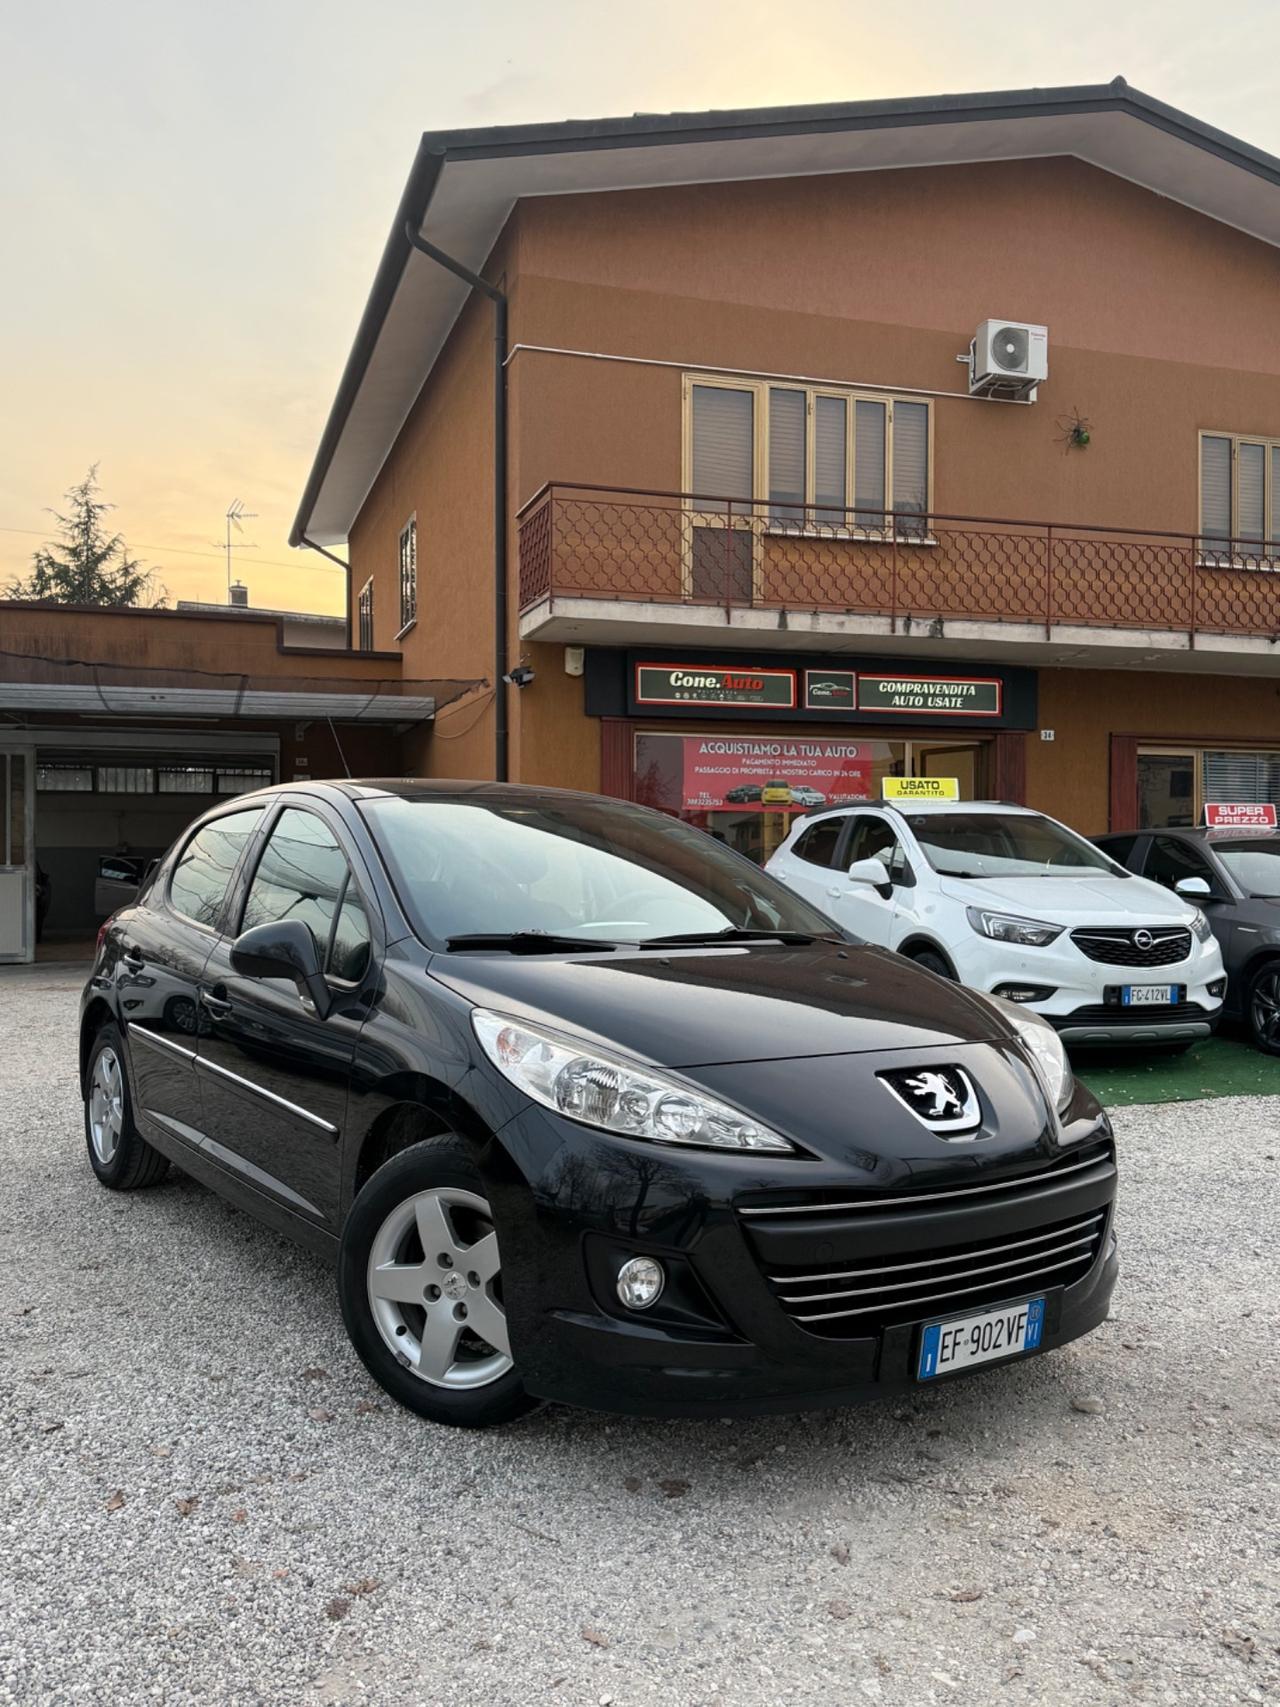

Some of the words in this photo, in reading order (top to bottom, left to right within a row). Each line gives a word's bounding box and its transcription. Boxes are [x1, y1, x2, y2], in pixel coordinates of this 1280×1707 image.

[670, 672, 764, 689] Cone.Auto
[879, 682, 976, 696] COMPRAVENDITA
[892, 696, 923, 707] AUTO
[928, 696, 963, 708] USATE
[699, 742, 780, 756] ACQUISTIAMO
[784, 744, 798, 756] LA
[800, 746, 823, 757] TUA
[825, 746, 857, 758] AUTO
[742, 758, 780, 766] PAGAMENTO
[782, 759, 816, 767] IMMEDIATO
[694, 766, 731, 774] PASSAGGIO
[900, 780, 940, 789] USATO
[1218, 806, 1264, 815] SUPER
